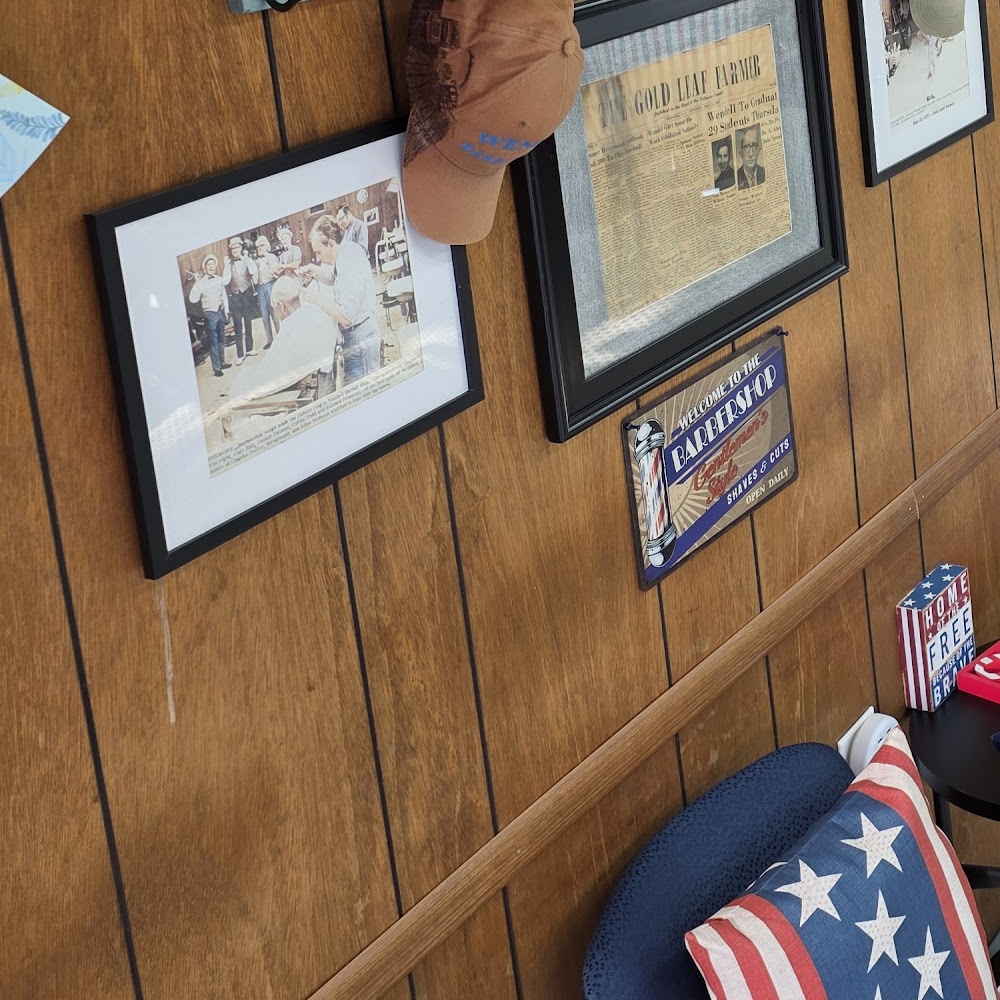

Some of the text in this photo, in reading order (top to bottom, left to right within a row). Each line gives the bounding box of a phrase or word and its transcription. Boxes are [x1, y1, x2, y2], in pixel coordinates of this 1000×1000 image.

[598, 94, 628, 128] TE
[634, 82, 671, 115] GOLD
[677, 70, 708, 102] LEAF
[715, 54, 761, 90] FARMER
[707, 104, 736, 122] Wendell
[738, 101, 749, 113] To
[708, 125, 719, 137] 29
[720, 116, 750, 133] Students
[671, 364, 777, 474] BARBERSHOP
[678, 352, 762, 431] WELCOME TO THE
[692, 407, 769, 492] Gentlemen's
[727, 438, 790, 505] SHAVES & CUTS
[706, 461, 739, 505] Style
[745, 466, 790, 505] OPEN DAILY
[925, 571, 969, 630] HOME
[936, 602, 960, 632] OF THE
[929, 607, 972, 672] FREE
[932, 635, 974, 687] BECAUSE OF THE
